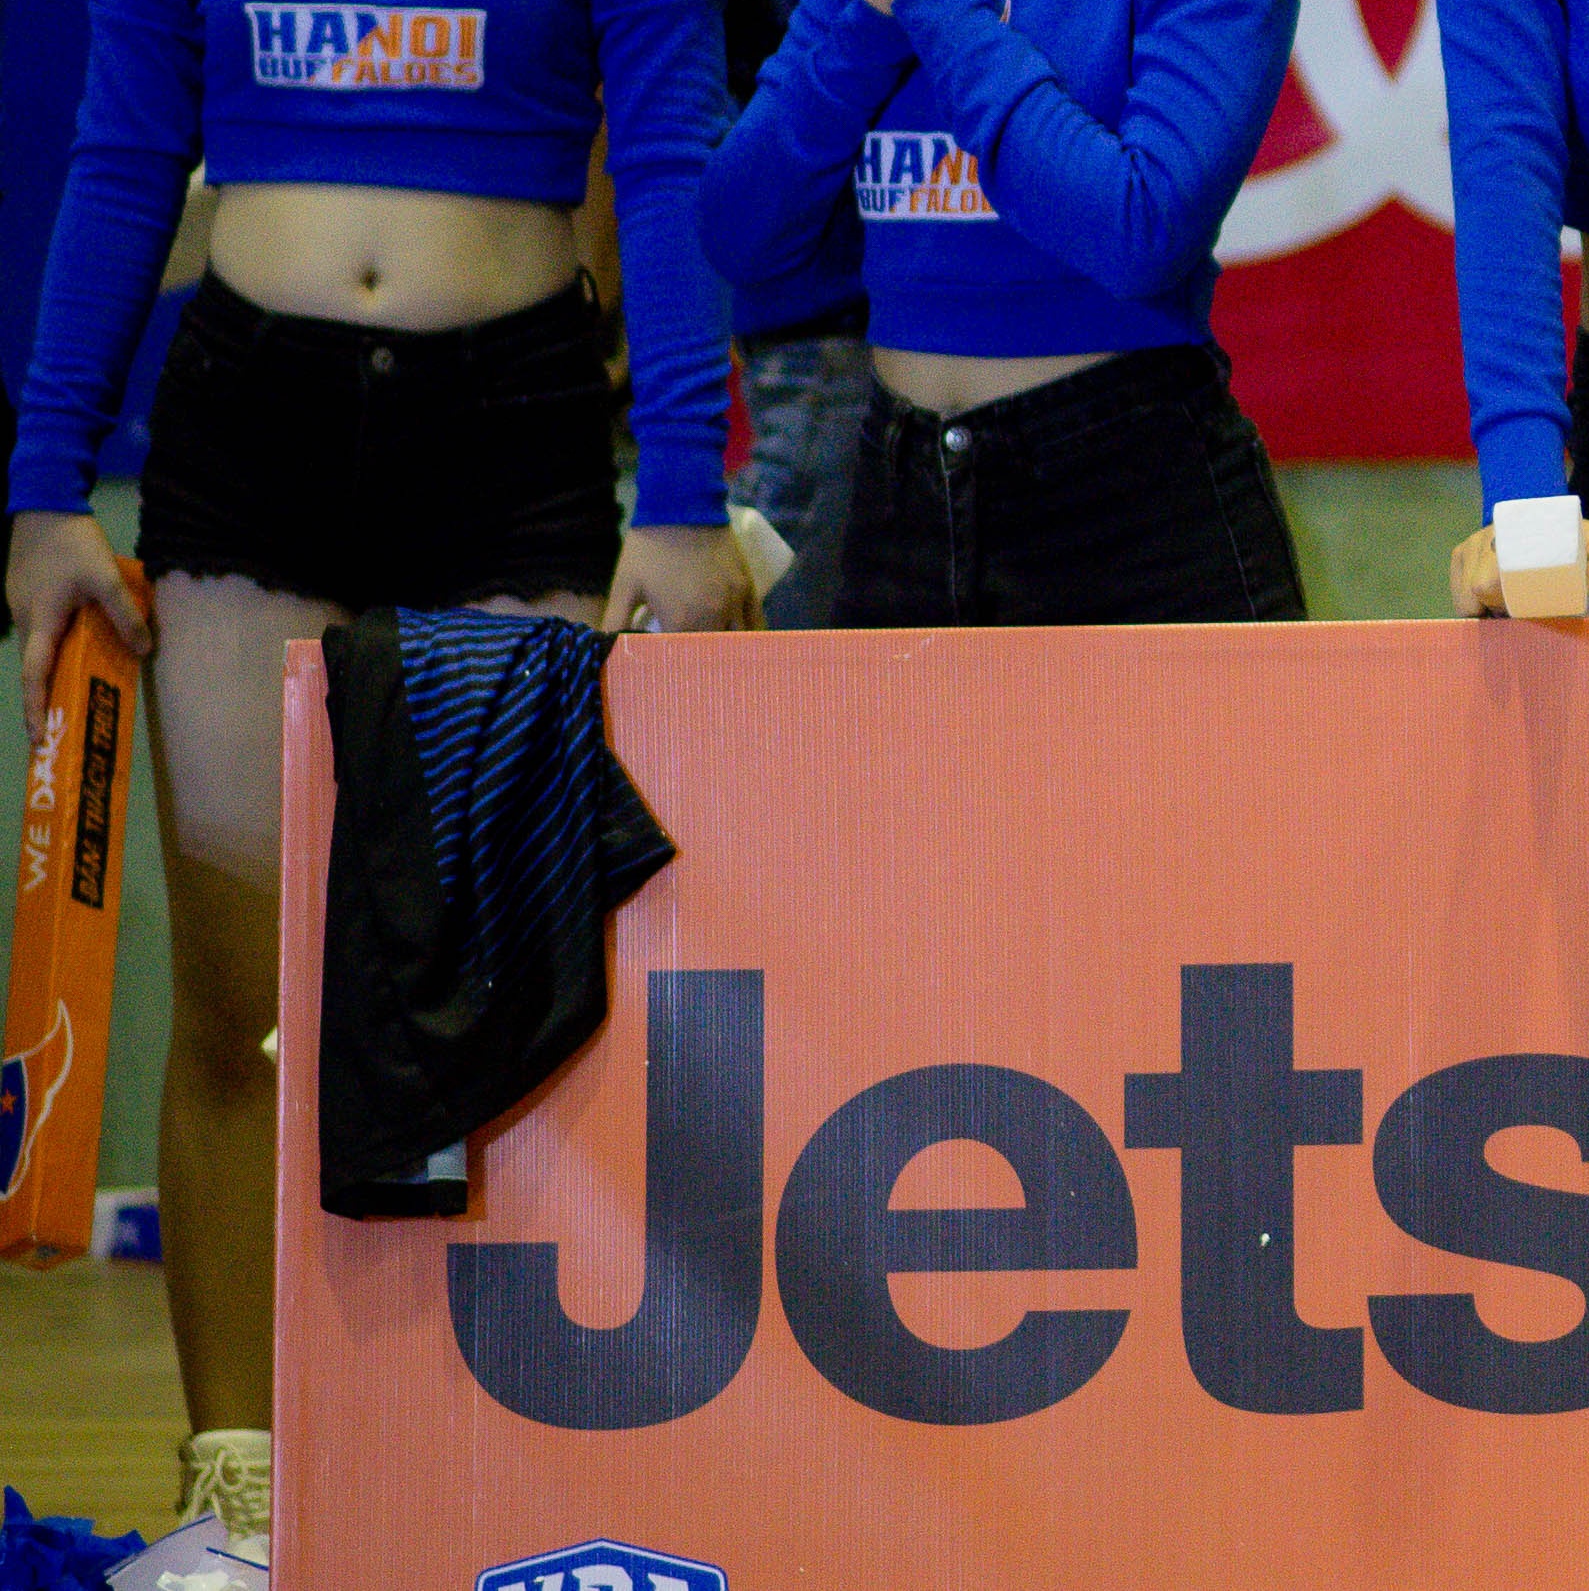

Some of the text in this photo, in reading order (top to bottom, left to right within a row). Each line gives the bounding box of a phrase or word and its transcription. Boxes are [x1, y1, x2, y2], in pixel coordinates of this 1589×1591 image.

[253, 10, 478, 59] HANOI
[257, 58, 478, 85] BUFFALOES
[23, 822, 52, 892] WE
